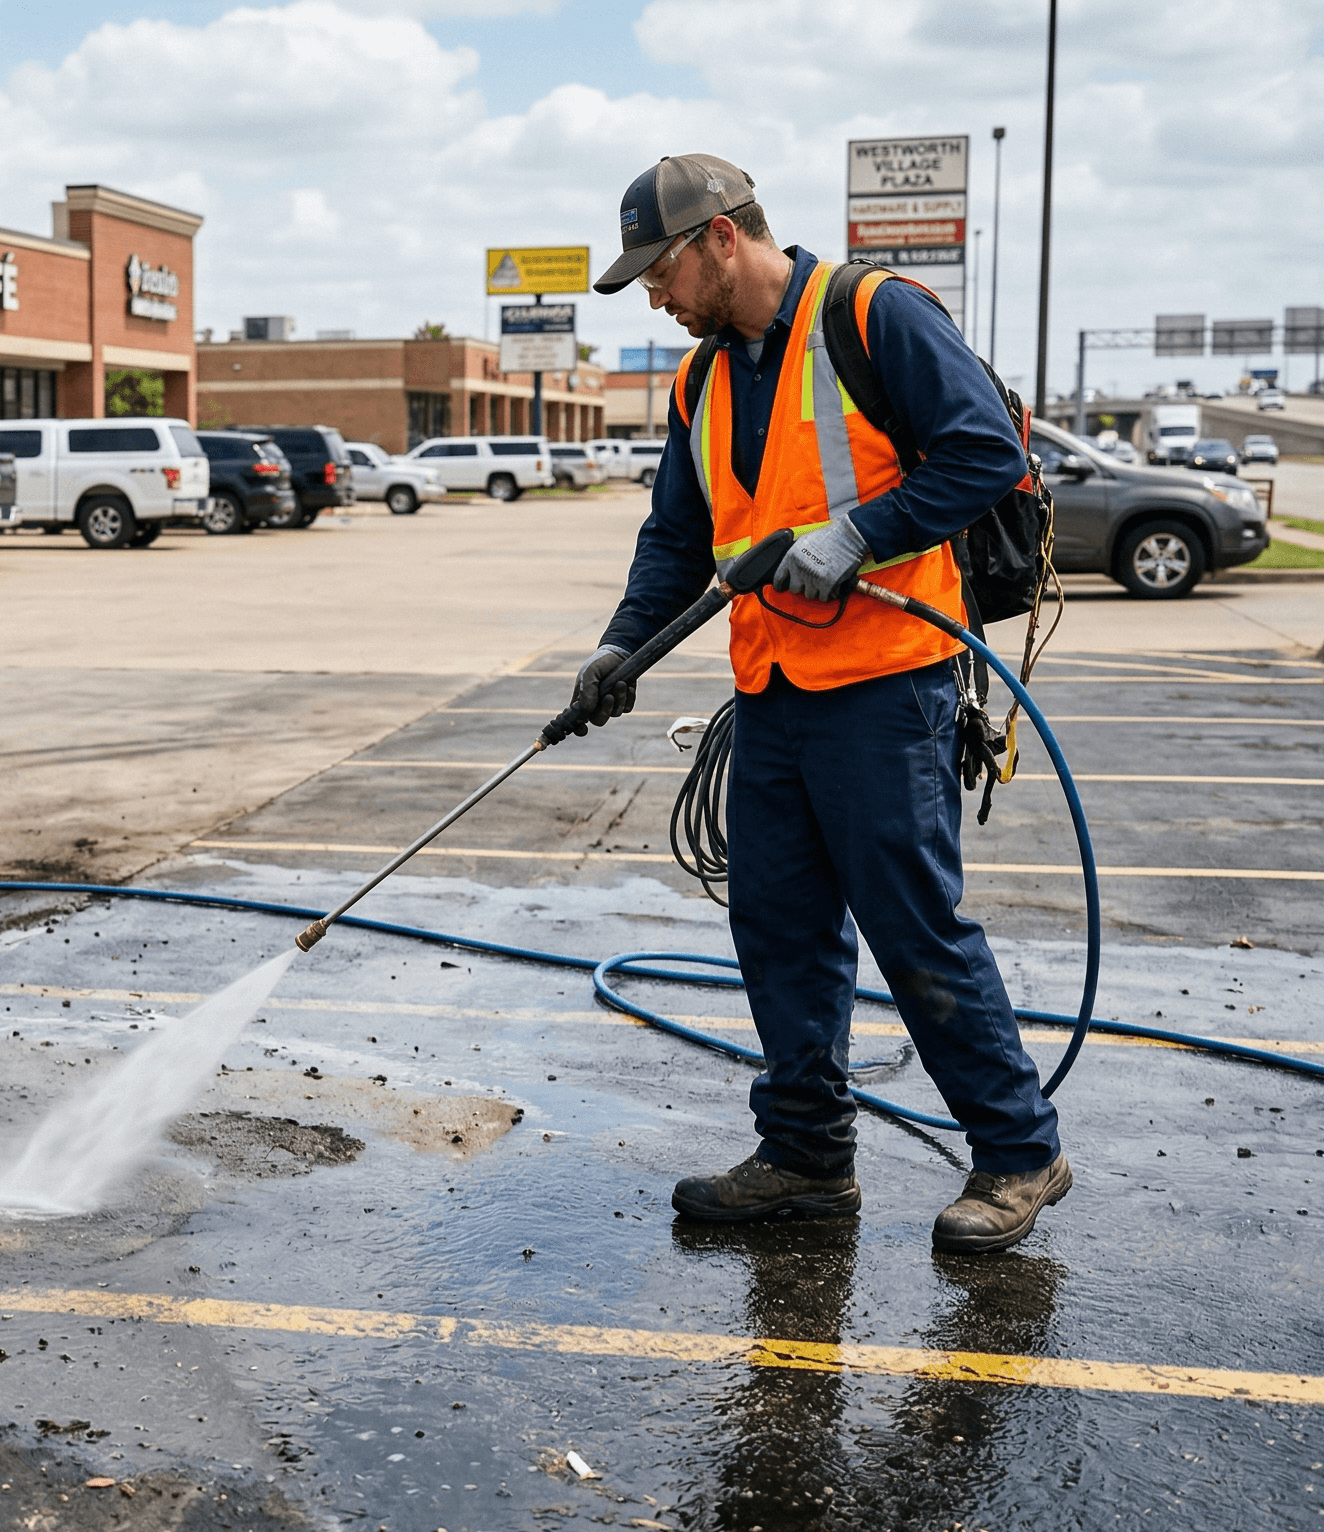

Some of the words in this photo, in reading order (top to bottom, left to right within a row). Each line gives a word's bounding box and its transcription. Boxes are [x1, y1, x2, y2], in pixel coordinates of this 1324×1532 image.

[856, 141, 961, 157] WESTWORTH
[875, 158, 941, 172] VILLAGE
[882, 174, 934, 187] PLAZA
[852, 203, 907, 214] HARDWARE
[924, 201, 962, 213] SUPPLY
